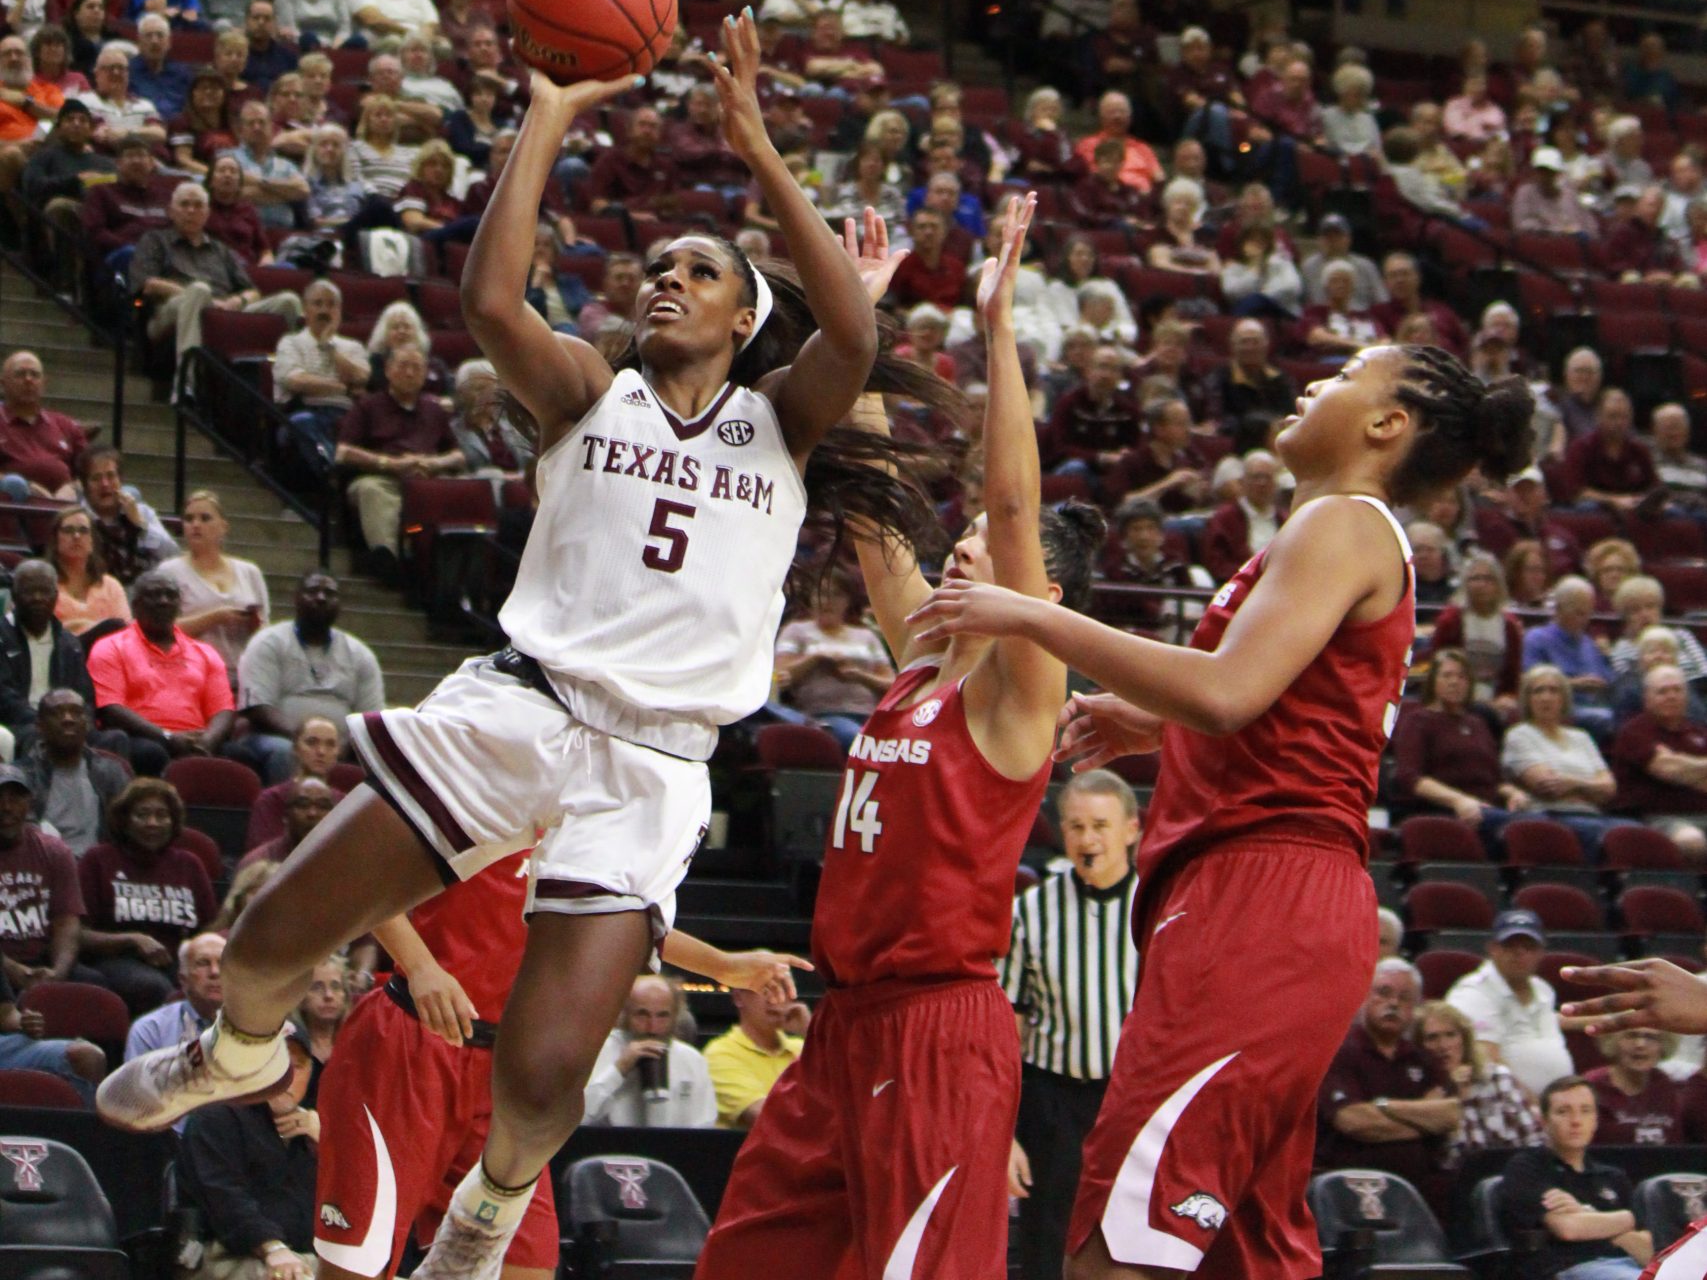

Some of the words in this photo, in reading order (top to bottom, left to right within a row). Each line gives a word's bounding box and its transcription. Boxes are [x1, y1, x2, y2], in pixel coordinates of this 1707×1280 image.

[620, 397, 652, 409] adidas
[720, 421, 752, 445] SEC
[583, 435, 702, 491] TEXAS
[710, 464, 775, 516] A&M
[641, 497, 697, 574] 5
[832, 768, 882, 853] 14
[114, 895, 198, 929] AGGIES
